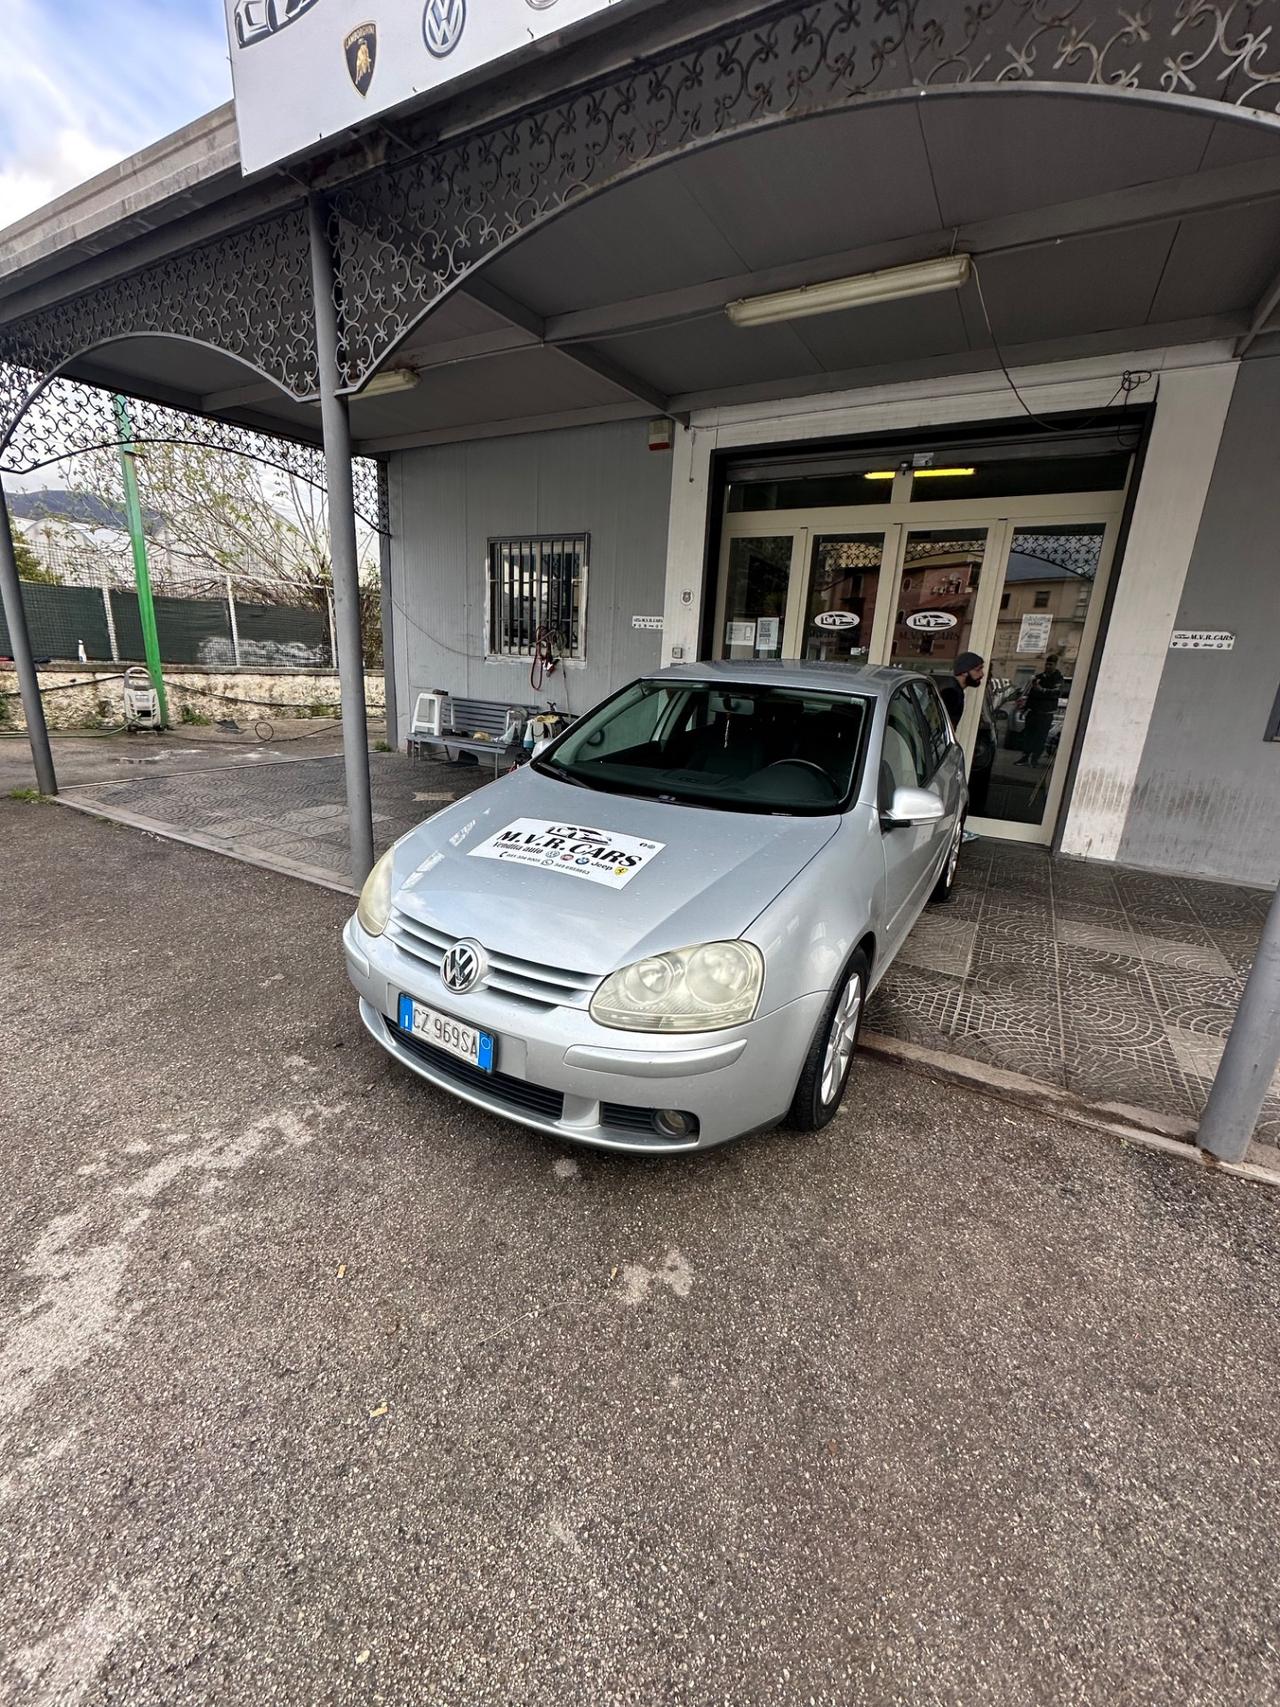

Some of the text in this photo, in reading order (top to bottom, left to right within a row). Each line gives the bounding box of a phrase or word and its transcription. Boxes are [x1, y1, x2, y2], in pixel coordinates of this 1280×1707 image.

[522, 846, 544, 855] auto
[591, 861, 613, 871] Jeep
[413, 1007, 430, 1034] CZ
[434, 1018, 478, 1060] 969SA
